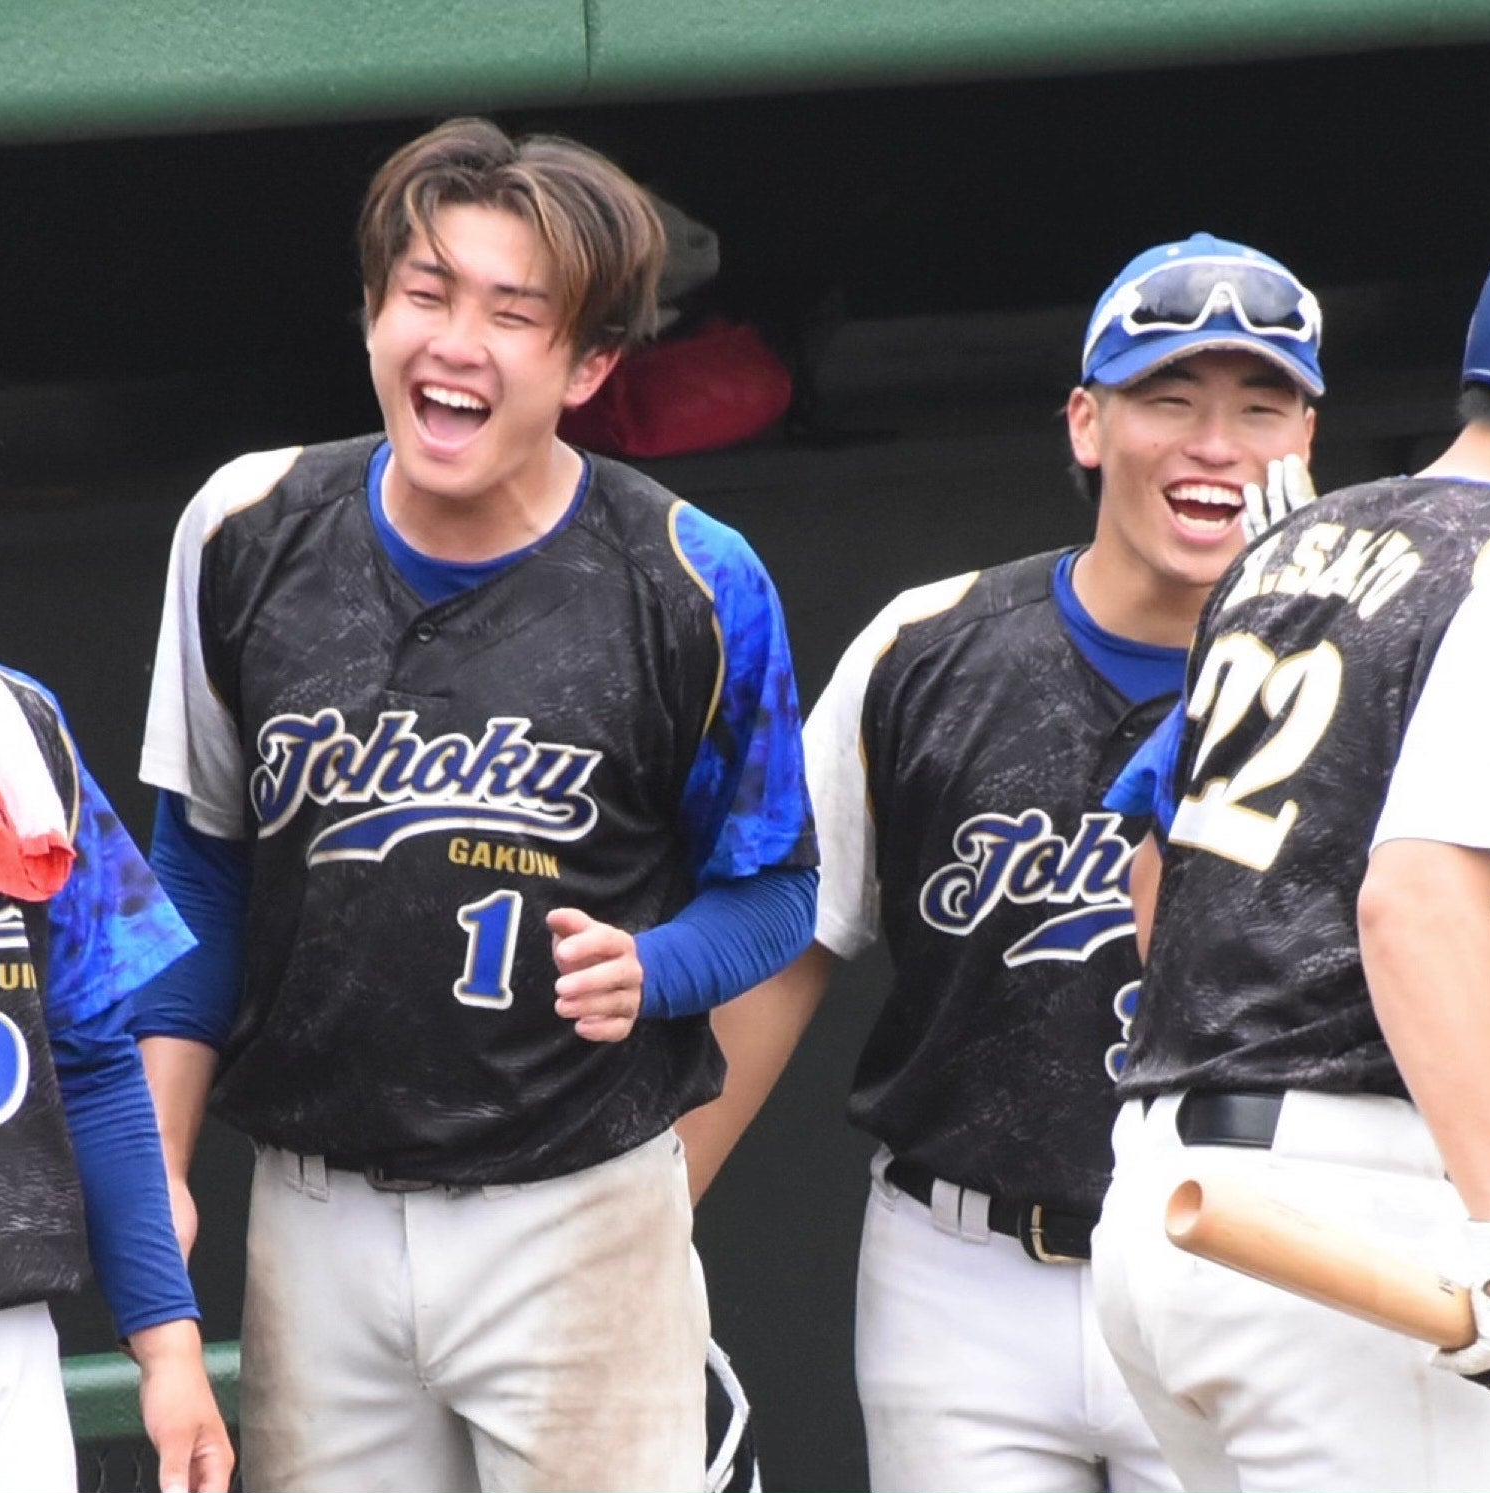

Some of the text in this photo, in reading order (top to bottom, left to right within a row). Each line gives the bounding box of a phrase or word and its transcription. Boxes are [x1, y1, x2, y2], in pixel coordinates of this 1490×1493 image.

[251, 708, 603, 840] Tohoku
[1168, 631, 1343, 872] 22
[448, 836, 561, 879] GAKUIN
[454, 889, 523, 1010] 1
